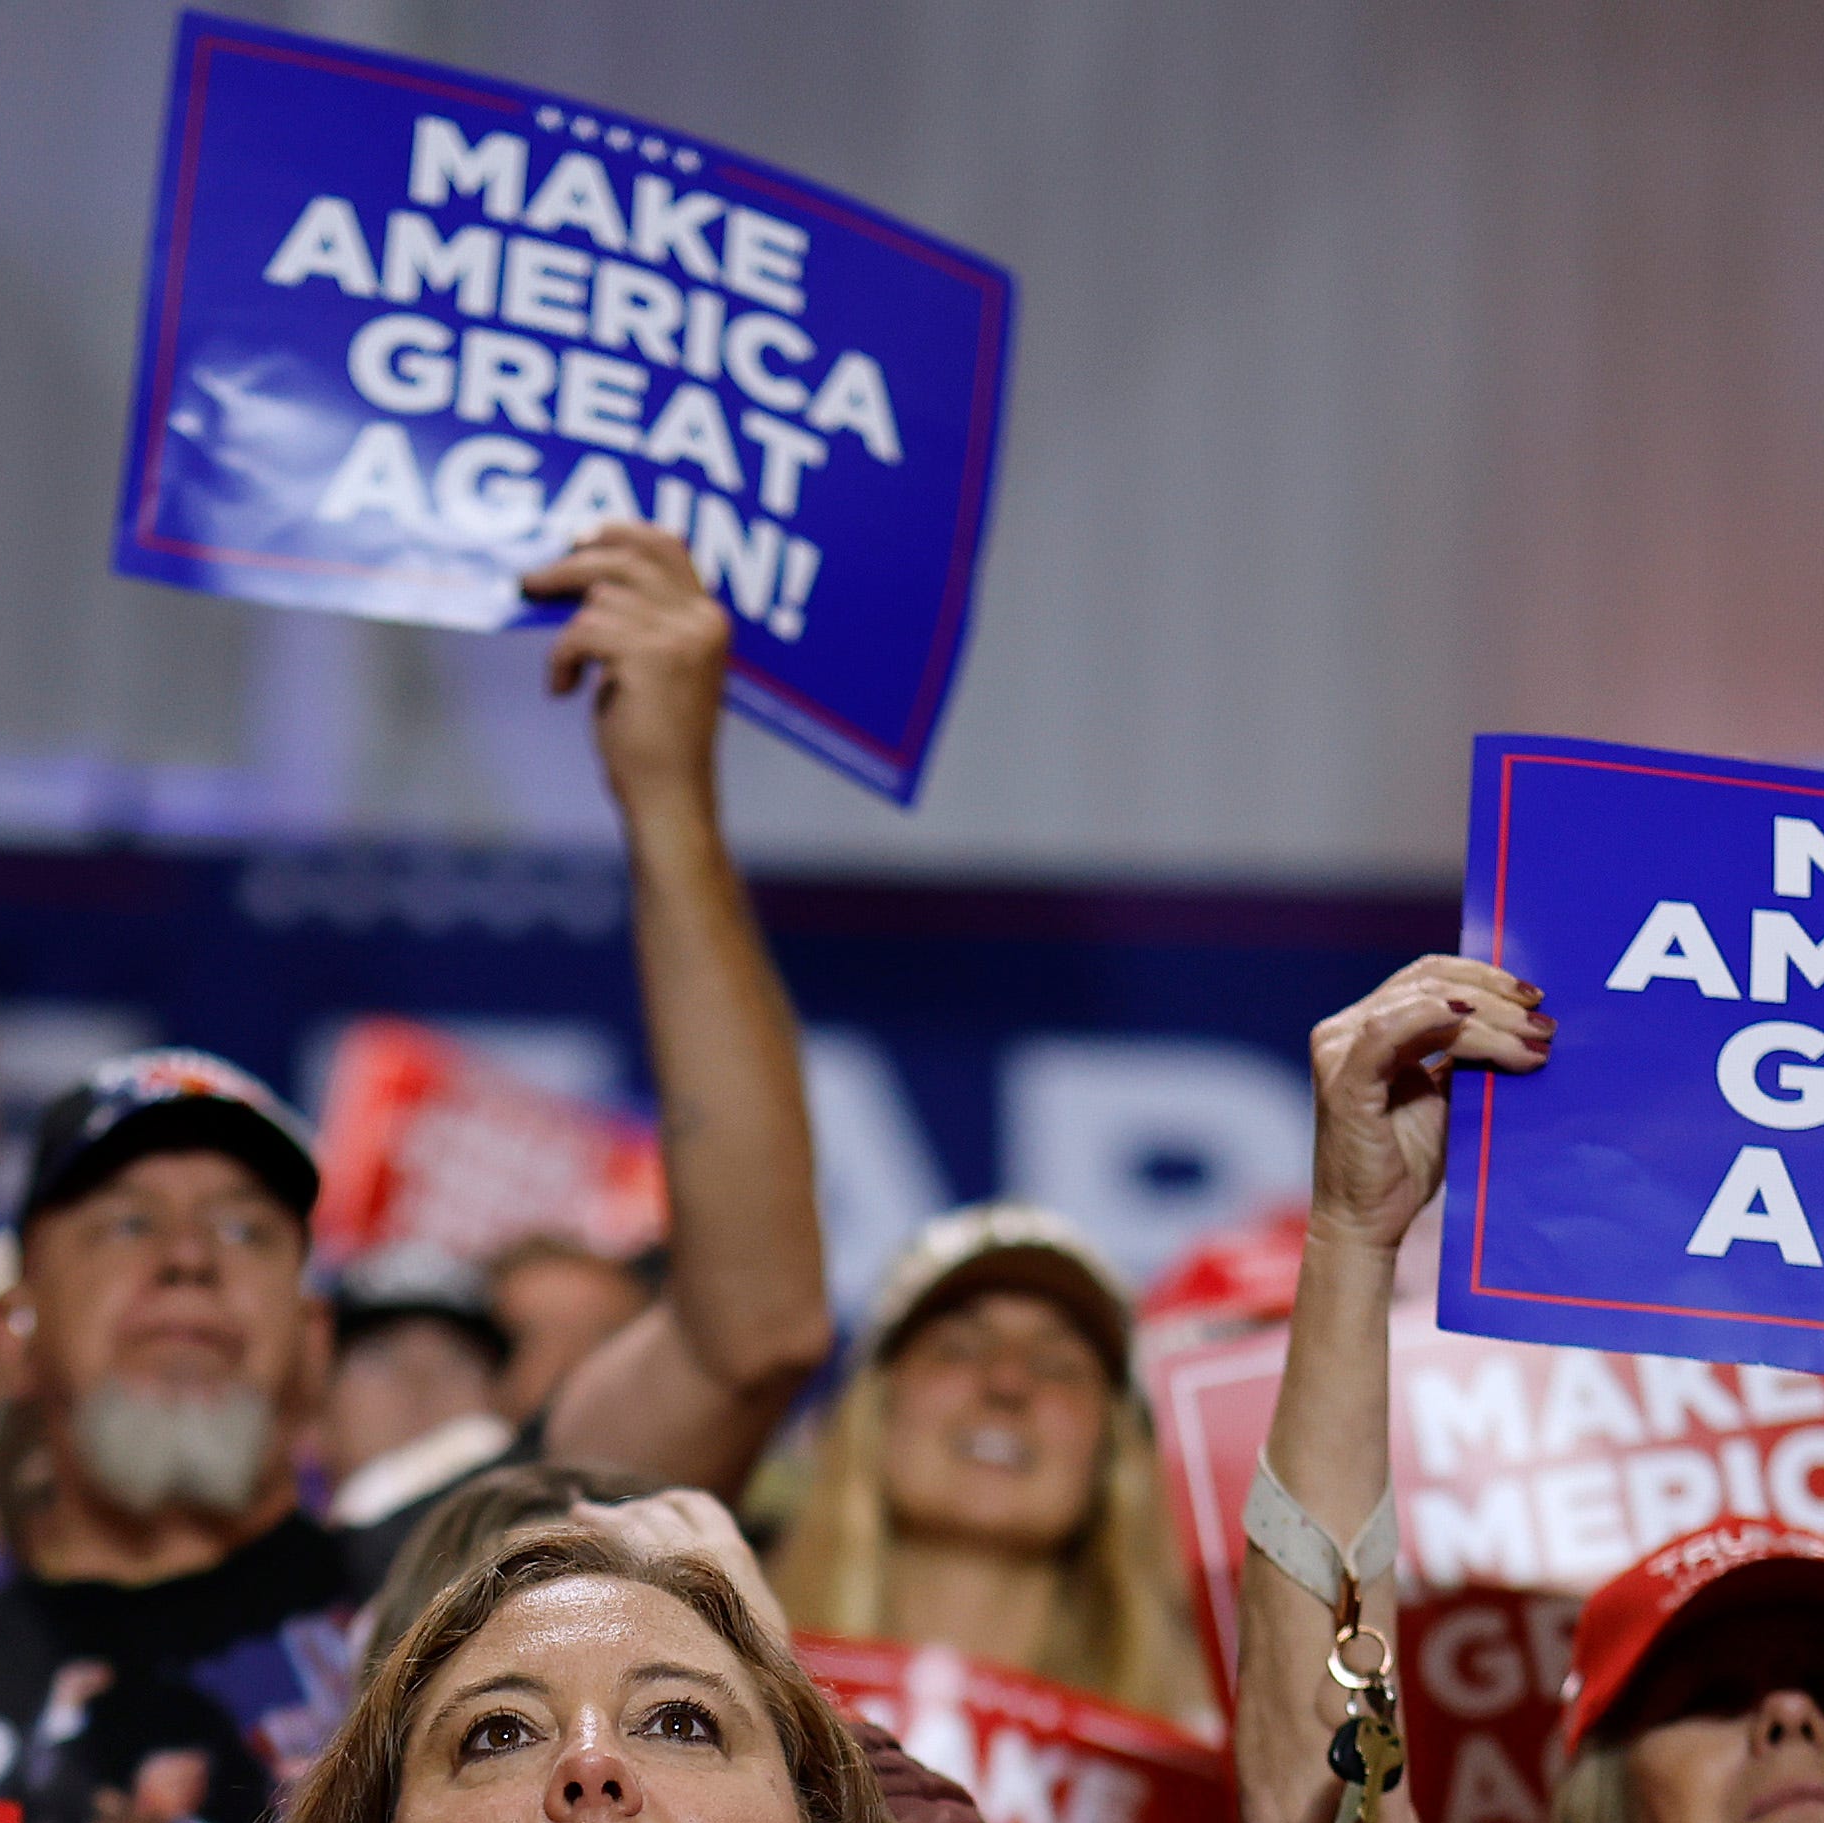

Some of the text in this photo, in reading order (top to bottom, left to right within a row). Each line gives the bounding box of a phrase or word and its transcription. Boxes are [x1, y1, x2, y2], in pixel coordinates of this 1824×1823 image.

[410, 118, 806, 312] MAKE
[265, 198, 898, 460] AMERICA
[349, 315, 825, 514] GREAT
